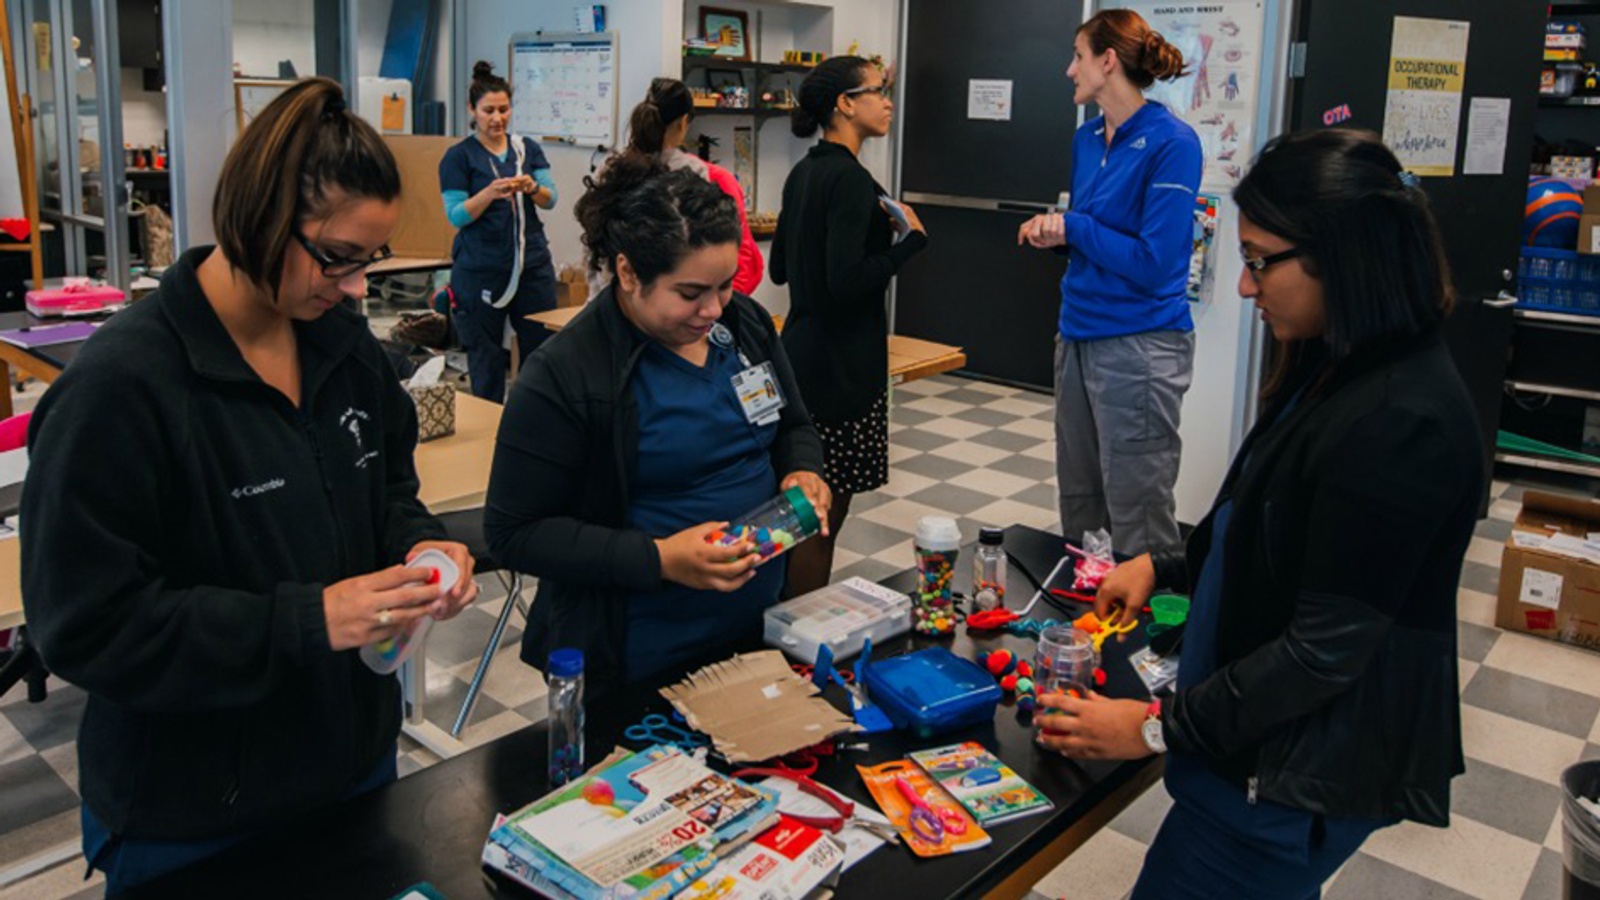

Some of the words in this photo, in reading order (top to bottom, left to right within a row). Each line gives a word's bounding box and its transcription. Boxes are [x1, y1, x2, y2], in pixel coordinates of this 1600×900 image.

[1153, 7, 1176, 15] HAND
[1178, 6, 1195, 14] AND
[1394, 60, 1459, 77] OCCUPATIONAL
[1406, 76, 1447, 90] THERAPY
[1323, 103, 1352, 126] OTA
